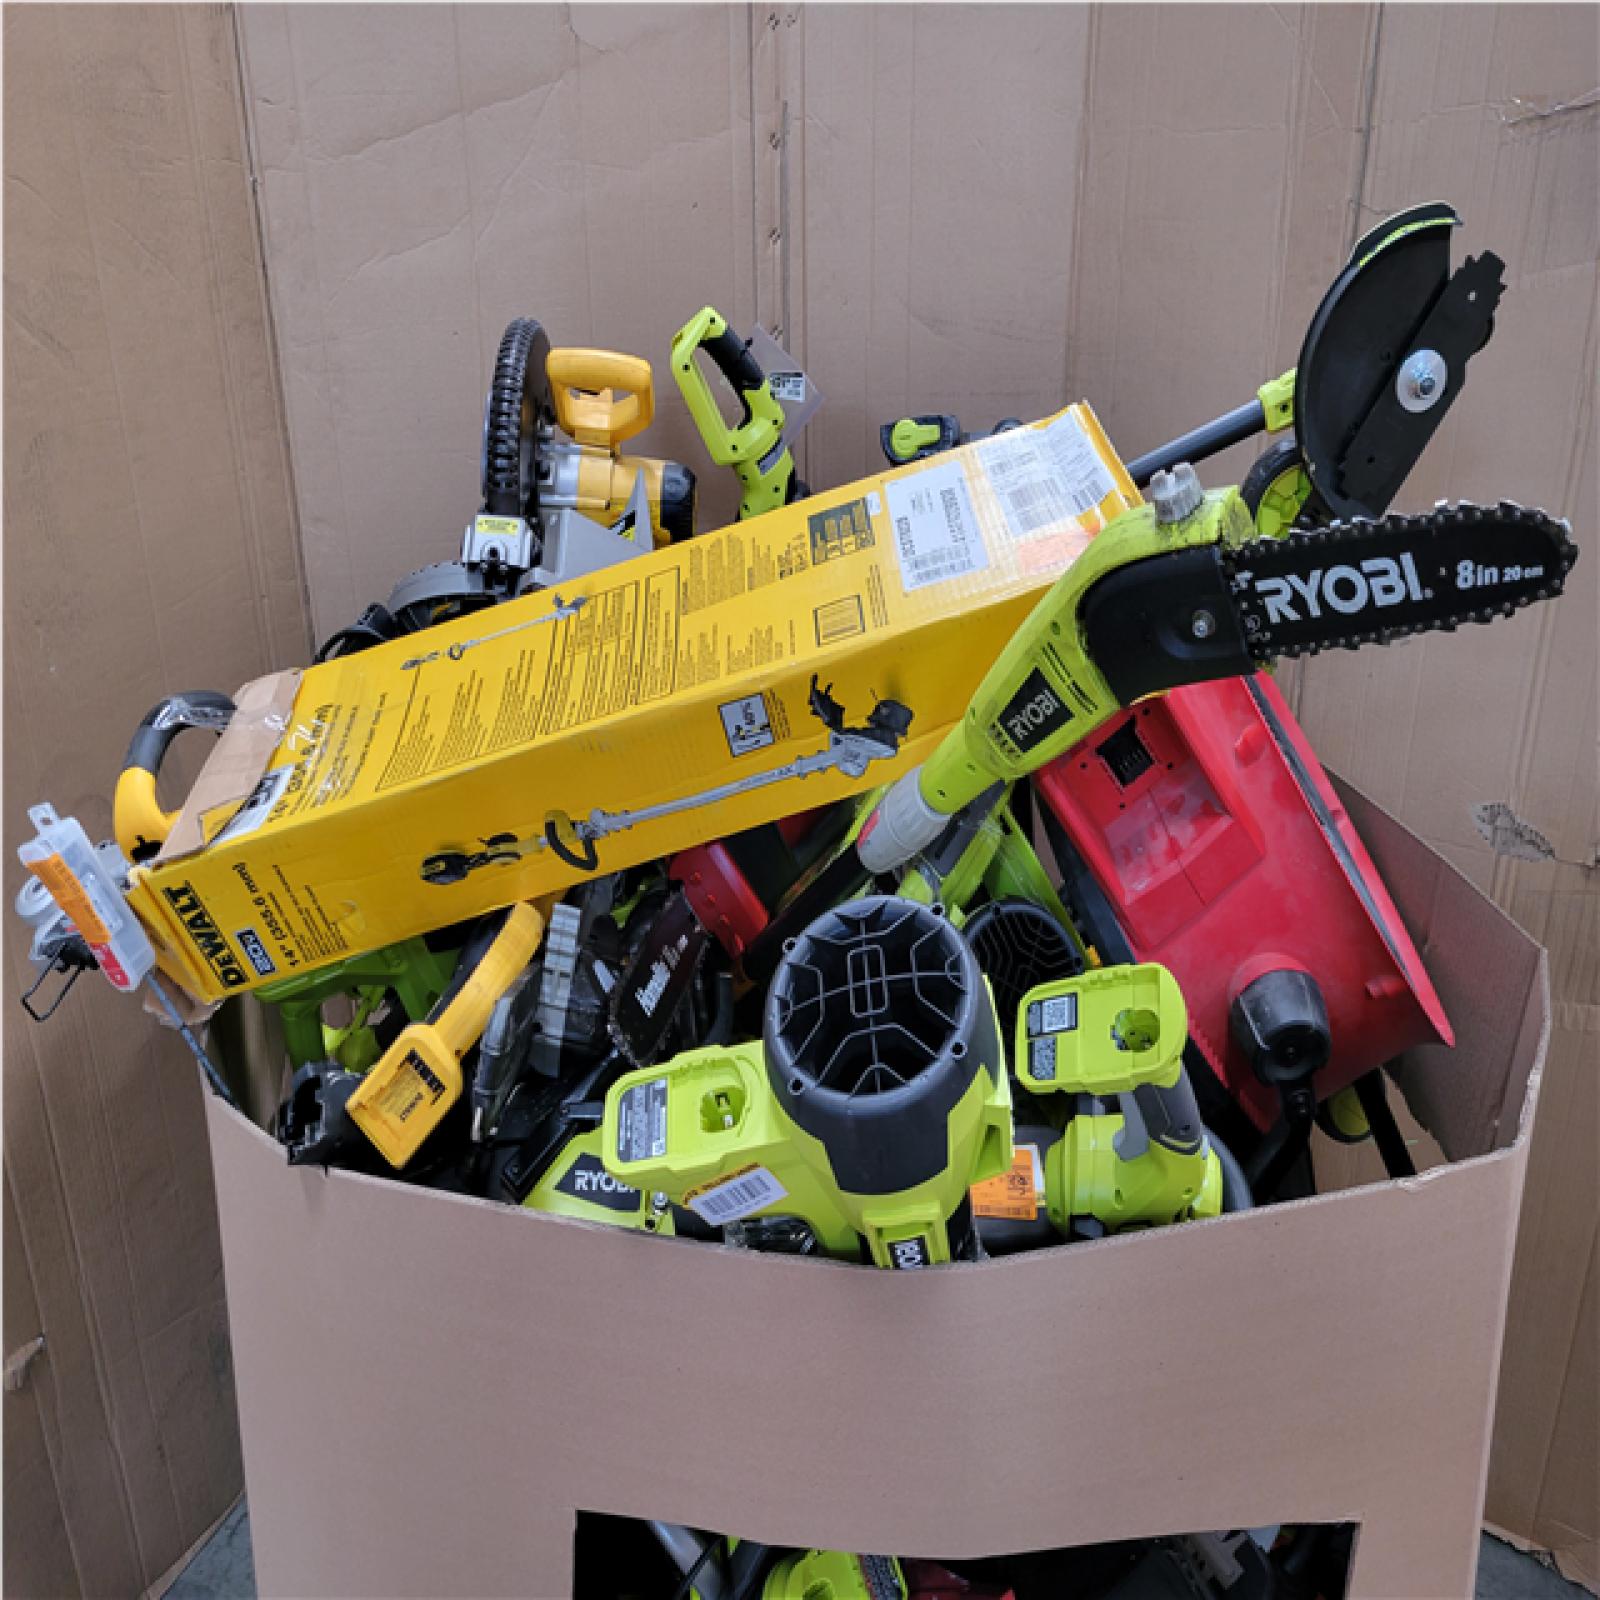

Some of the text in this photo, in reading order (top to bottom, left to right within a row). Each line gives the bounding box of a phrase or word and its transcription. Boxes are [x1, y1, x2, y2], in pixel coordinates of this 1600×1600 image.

[1255, 552, 1423, 624] RYOBI
[1456, 559, 1498, 590] 8in
[1007, 689, 1060, 740] RYOBI
[160, 879, 250, 990] DEWALT
[574, 1169, 637, 1193] RYO
